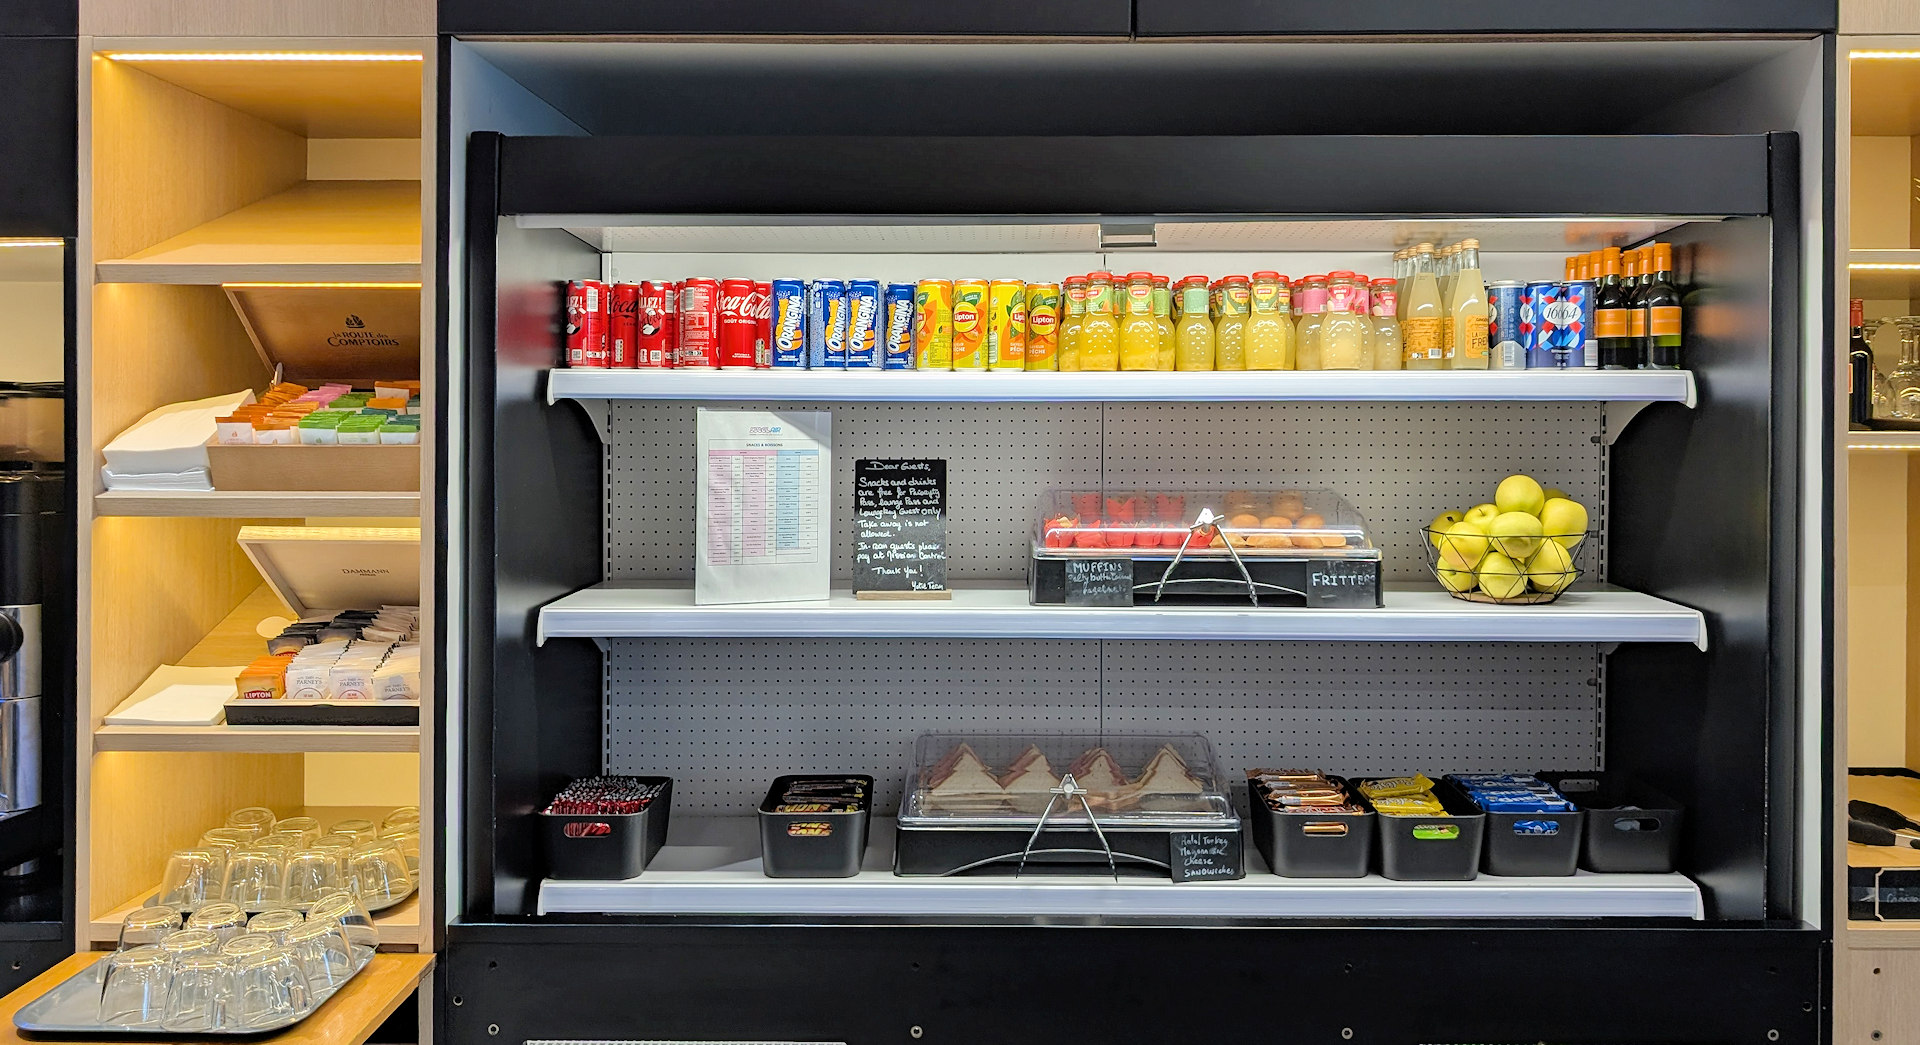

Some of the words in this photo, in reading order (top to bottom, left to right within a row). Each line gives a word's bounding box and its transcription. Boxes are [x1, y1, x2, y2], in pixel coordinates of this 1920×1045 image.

[777, 295, 802, 351] ORANGINA
[850, 295, 874, 350] ORANGINA
[887, 300, 910, 352] ORANGINA
[1032, 316, 1054, 325] Lipton
[327, 336, 400, 347] COMPTOIRS
[865, 461, 900, 470] Dear
[858, 477, 889, 487] Snacks
[890, 478, 907, 486] and
[908, 477, 937, 486] drinks
[877, 486, 893, 499] free
[896, 486, 907, 499] for
[904, 496, 921, 506] Pass
[857, 520, 878, 529] Take
[880, 521, 902, 531] away
[856, 553, 871, 564] pay
[872, 551, 886, 559] at
[871, 566, 901, 575] Thank
[1073, 562, 1123, 573] MUFFINS
[245, 691, 271, 699] LIPTON
